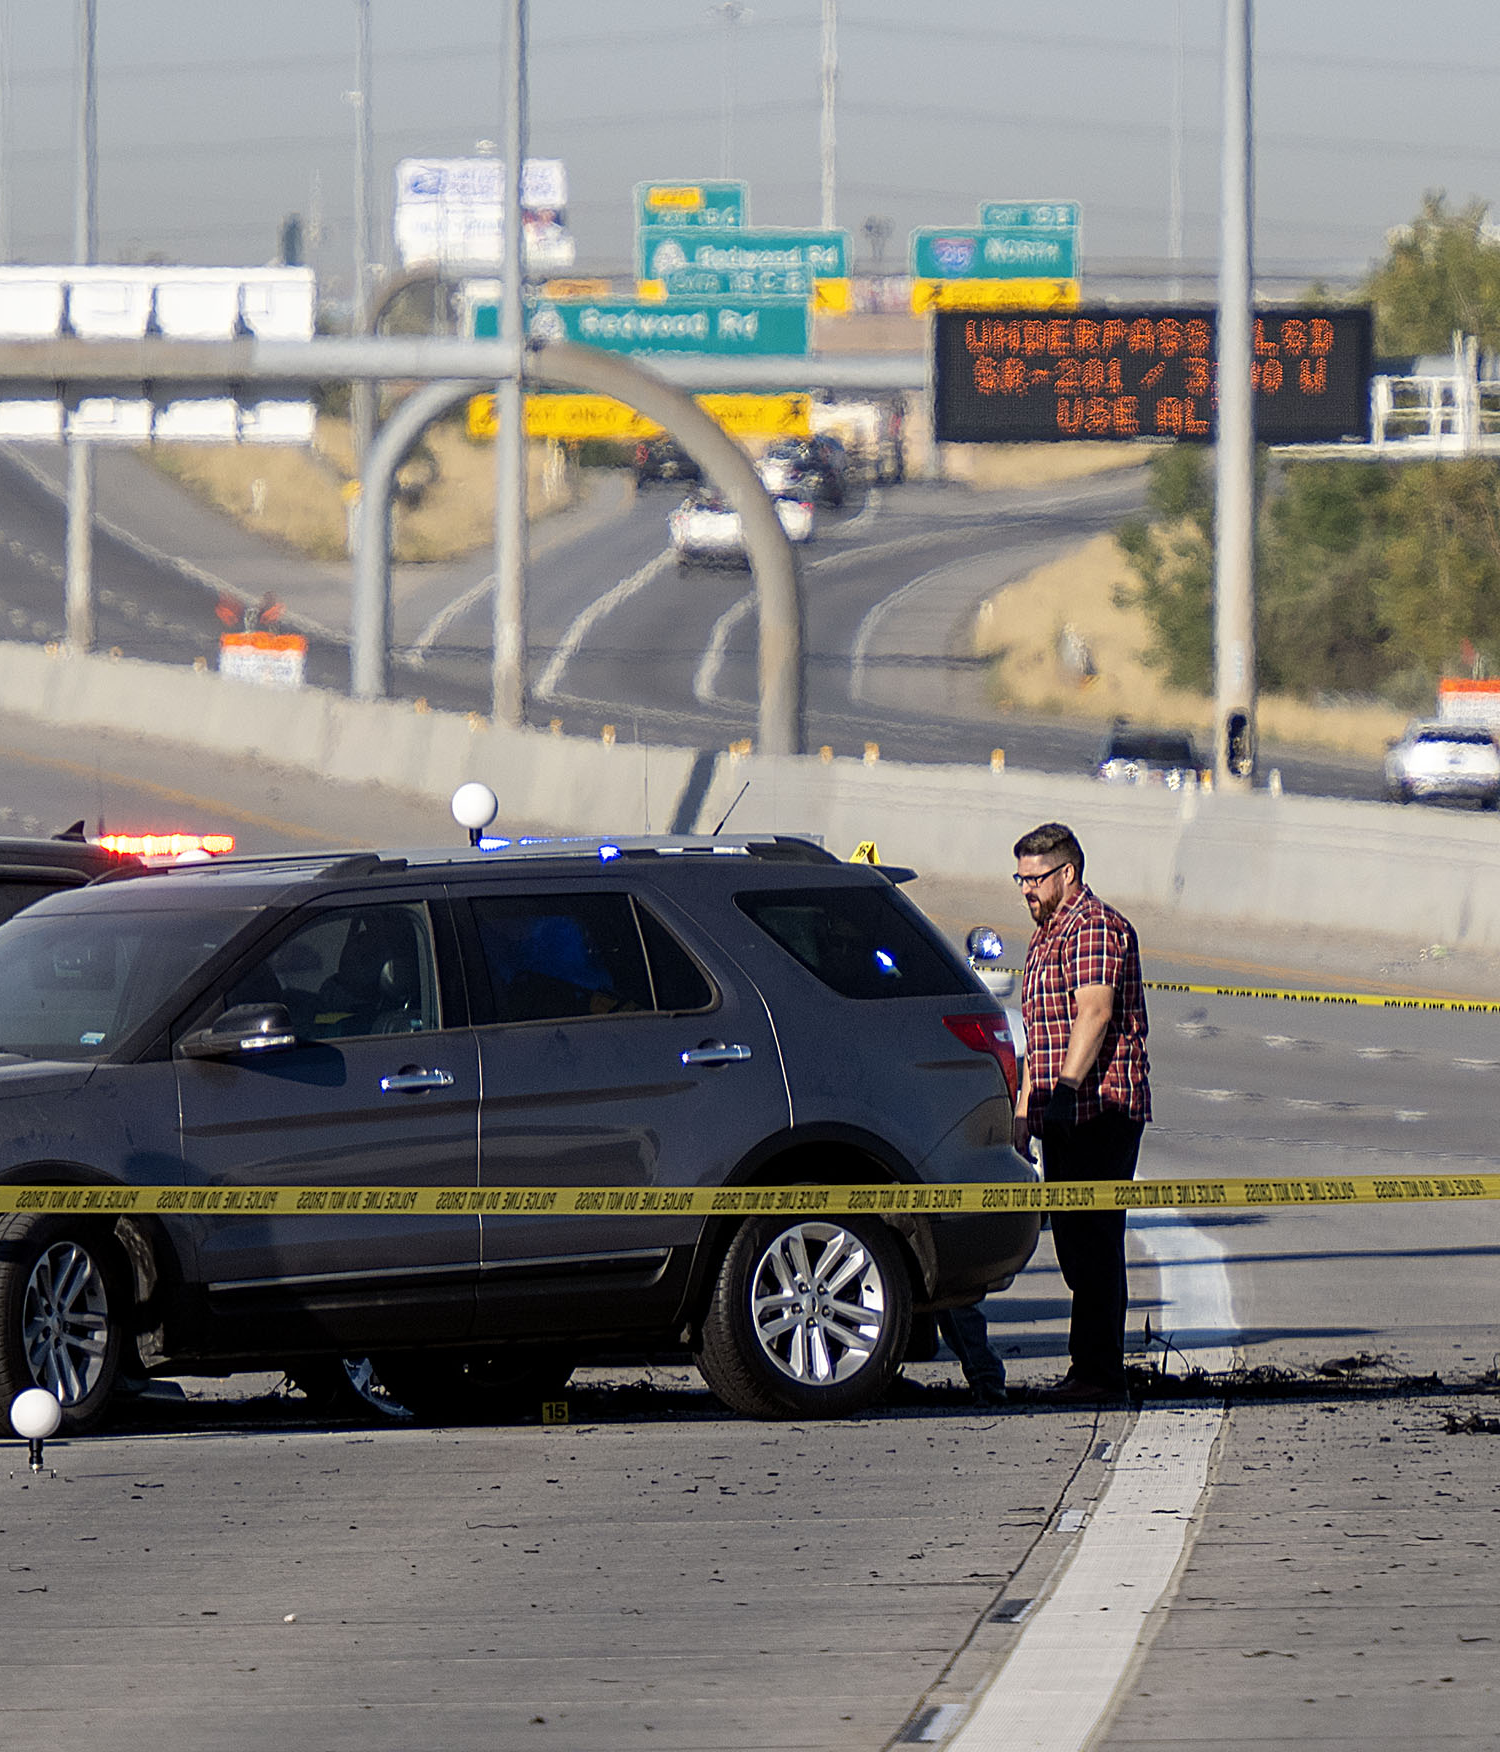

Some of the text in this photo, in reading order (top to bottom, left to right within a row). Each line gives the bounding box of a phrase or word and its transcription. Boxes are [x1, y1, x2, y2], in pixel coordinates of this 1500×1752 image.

[579, 308, 759, 340] Redwood Rd
[965, 318, 1211, 356] UNDERPASS
[1056, 396, 1140, 434] USE
[545, 1403, 566, 1419] 15
